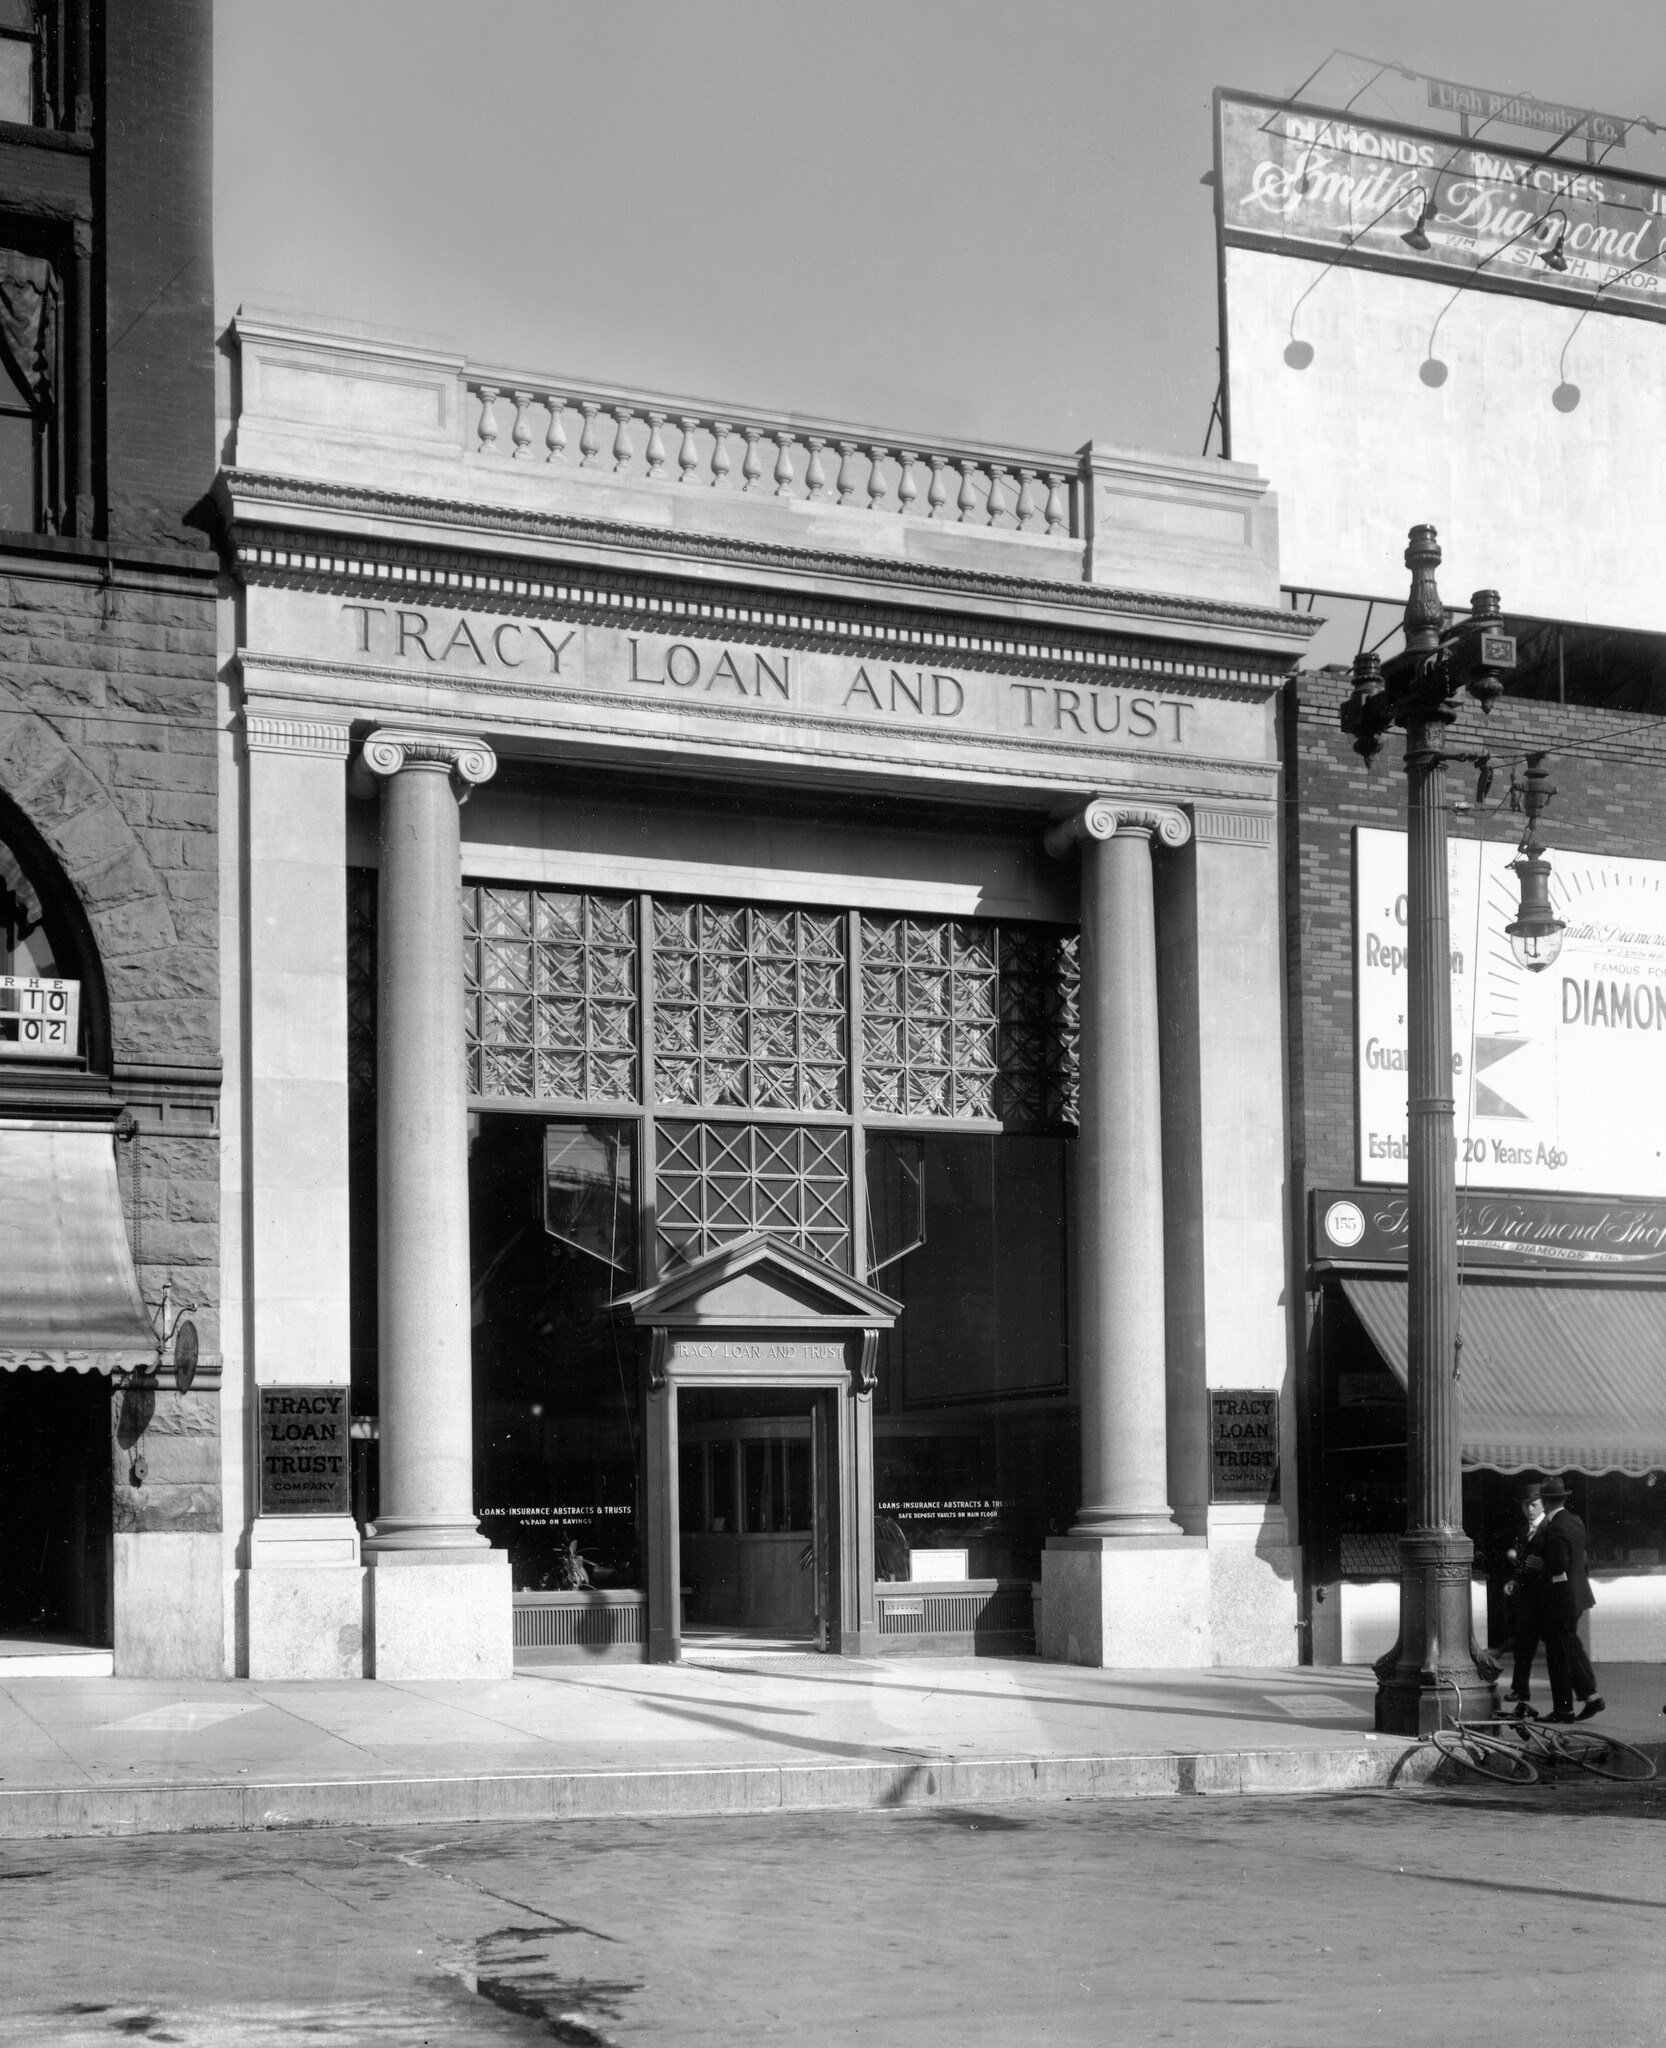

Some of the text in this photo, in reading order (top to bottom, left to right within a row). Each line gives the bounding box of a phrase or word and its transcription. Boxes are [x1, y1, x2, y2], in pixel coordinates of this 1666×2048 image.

[1437, 82, 1484, 112] Utah
[1286, 118, 1434, 168] DIAMONDS
[1473, 150, 1605, 202] WATCHES
[1434, 182, 1653, 262] Diamond
[340, 604, 1195, 743] TRACY LOAN AND TRUST
[1593, 962, 1641, 976] FAMOUS
[4, 977, 63, 990] R H E
[1462, 1137, 1487, 1163] 20
[1491, 1138, 1533, 1165] Years
[1535, 1141, 1568, 1170] Ago
[1334, 1217, 1357, 1230] 155
[1473, 1203, 1611, 1241] Diamond
[1466, 1240, 1620, 1262] WHOLESALE DIAMONDS RETAIL
[671, 1344, 843, 1359] TRACY LOAN AND TRUST
[264, 1397, 342, 1414] TRACY
[1214, 1399, 1273, 1415] TRACY
[271, 1424, 337, 1441] LOAN
[1220, 1424, 1269, 1438] LOAN
[265, 1455, 342, 1474] TRUST
[1215, 1451, 1274, 1466] TRUST
[274, 1482, 336, 1491] COMPANY
[479, 1508, 506, 1516] LOANS
[509, 1507, 550, 1515] INSURANCE
[553, 1506, 594, 1515] ABSTRACTS
[604, 1506, 632, 1514] TRUSTS
[903, 1501, 940, 1509] INSURANCE
[943, 1501, 982, 1509] ABSTRACTS
